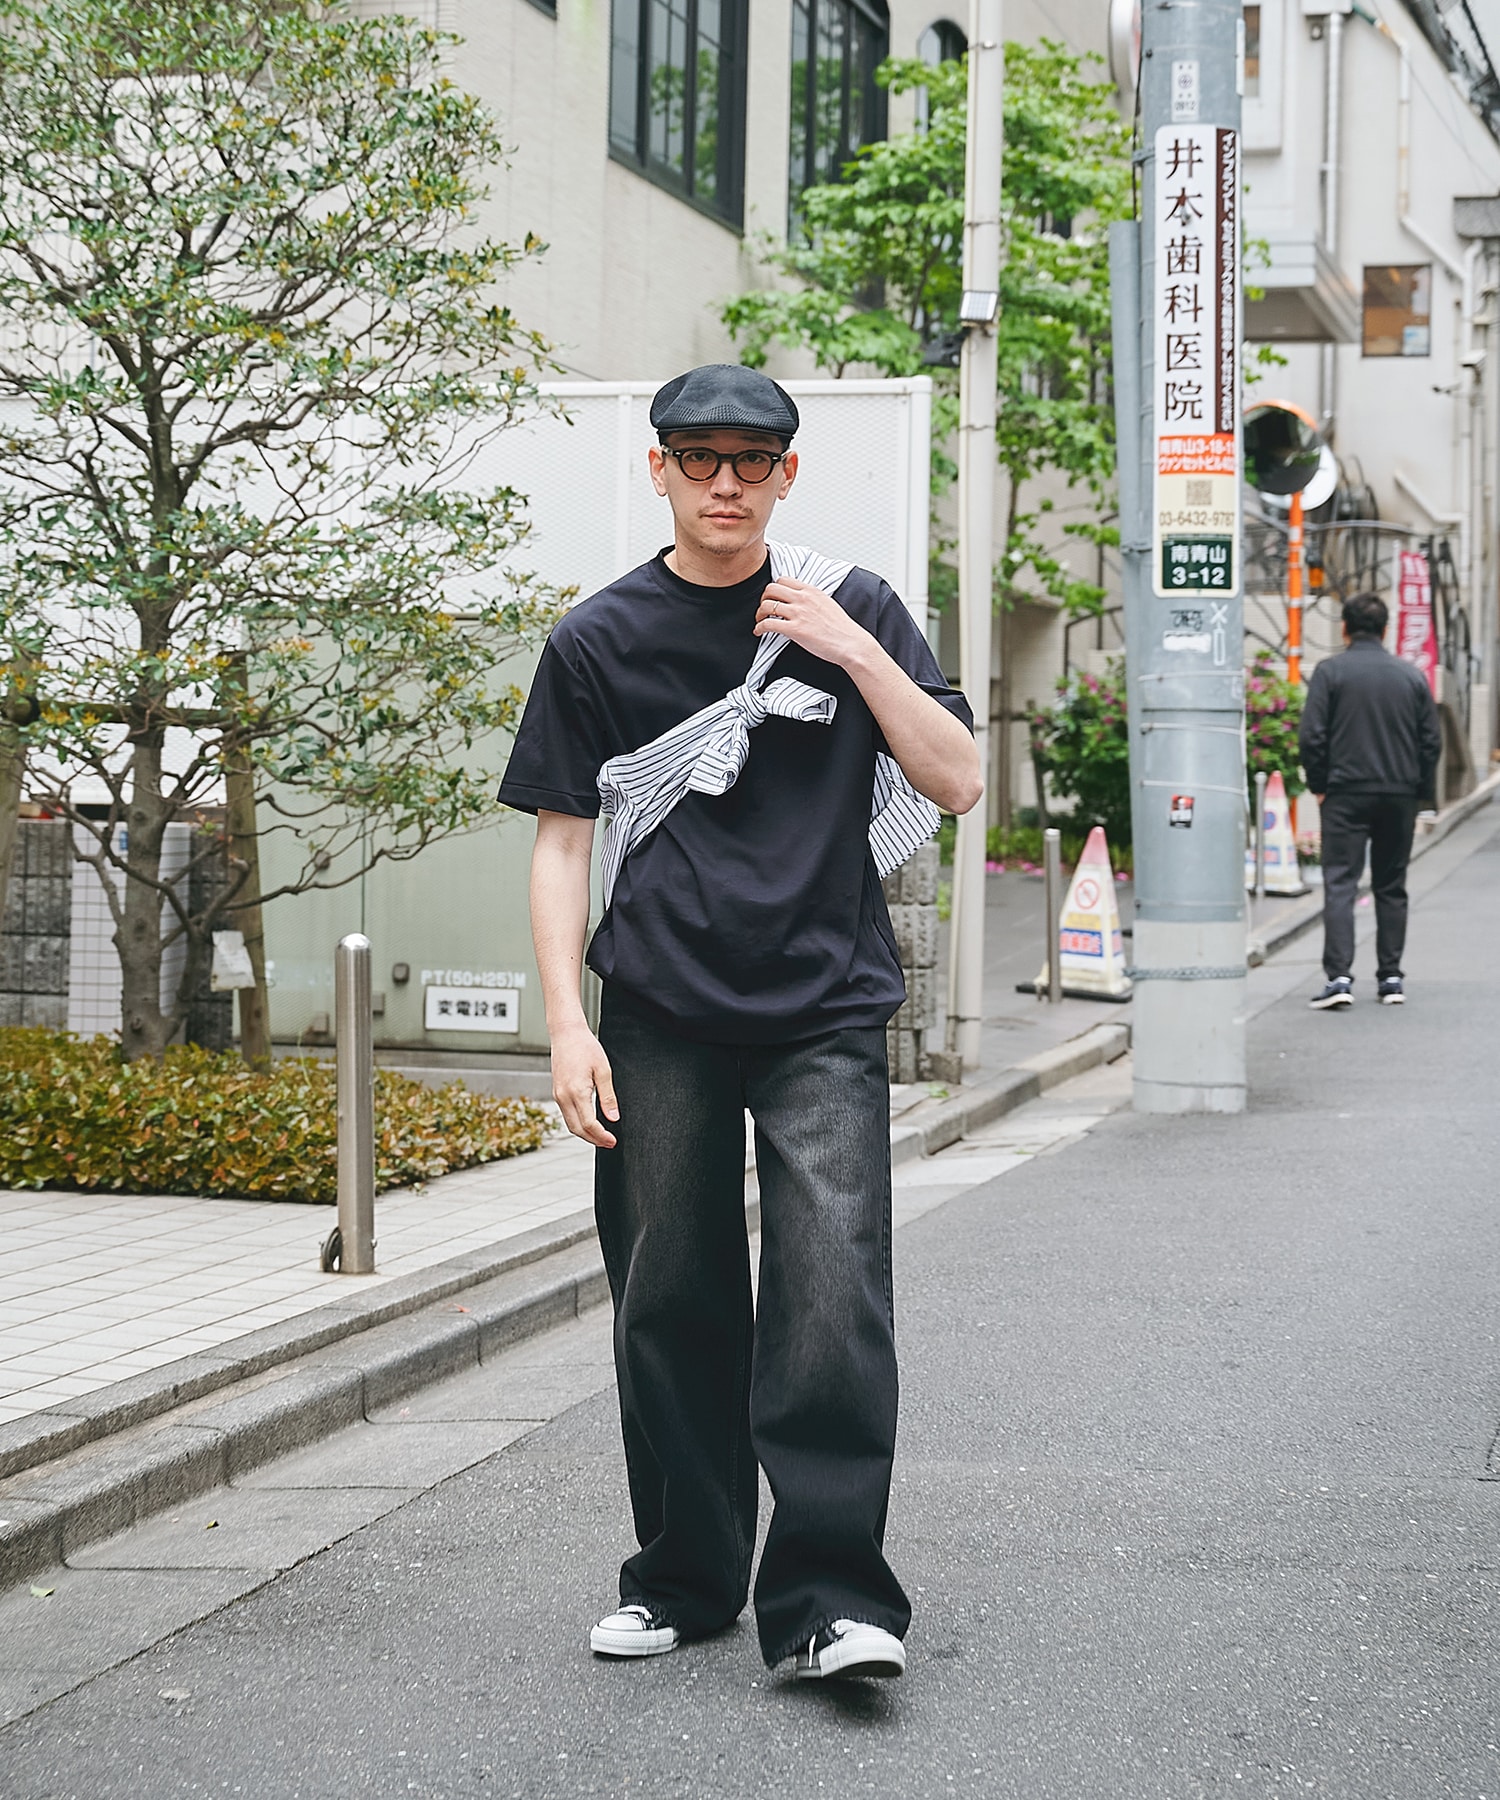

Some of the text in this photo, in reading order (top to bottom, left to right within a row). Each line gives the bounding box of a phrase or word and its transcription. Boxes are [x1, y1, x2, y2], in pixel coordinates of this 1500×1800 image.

[1164, 138, 1204, 421] 井本歯科医院
[1171, 544, 1227, 564] 南青山
[1171, 566, 1226, 586] 3-12
[437, 1000, 507, 1018] 変電設備
